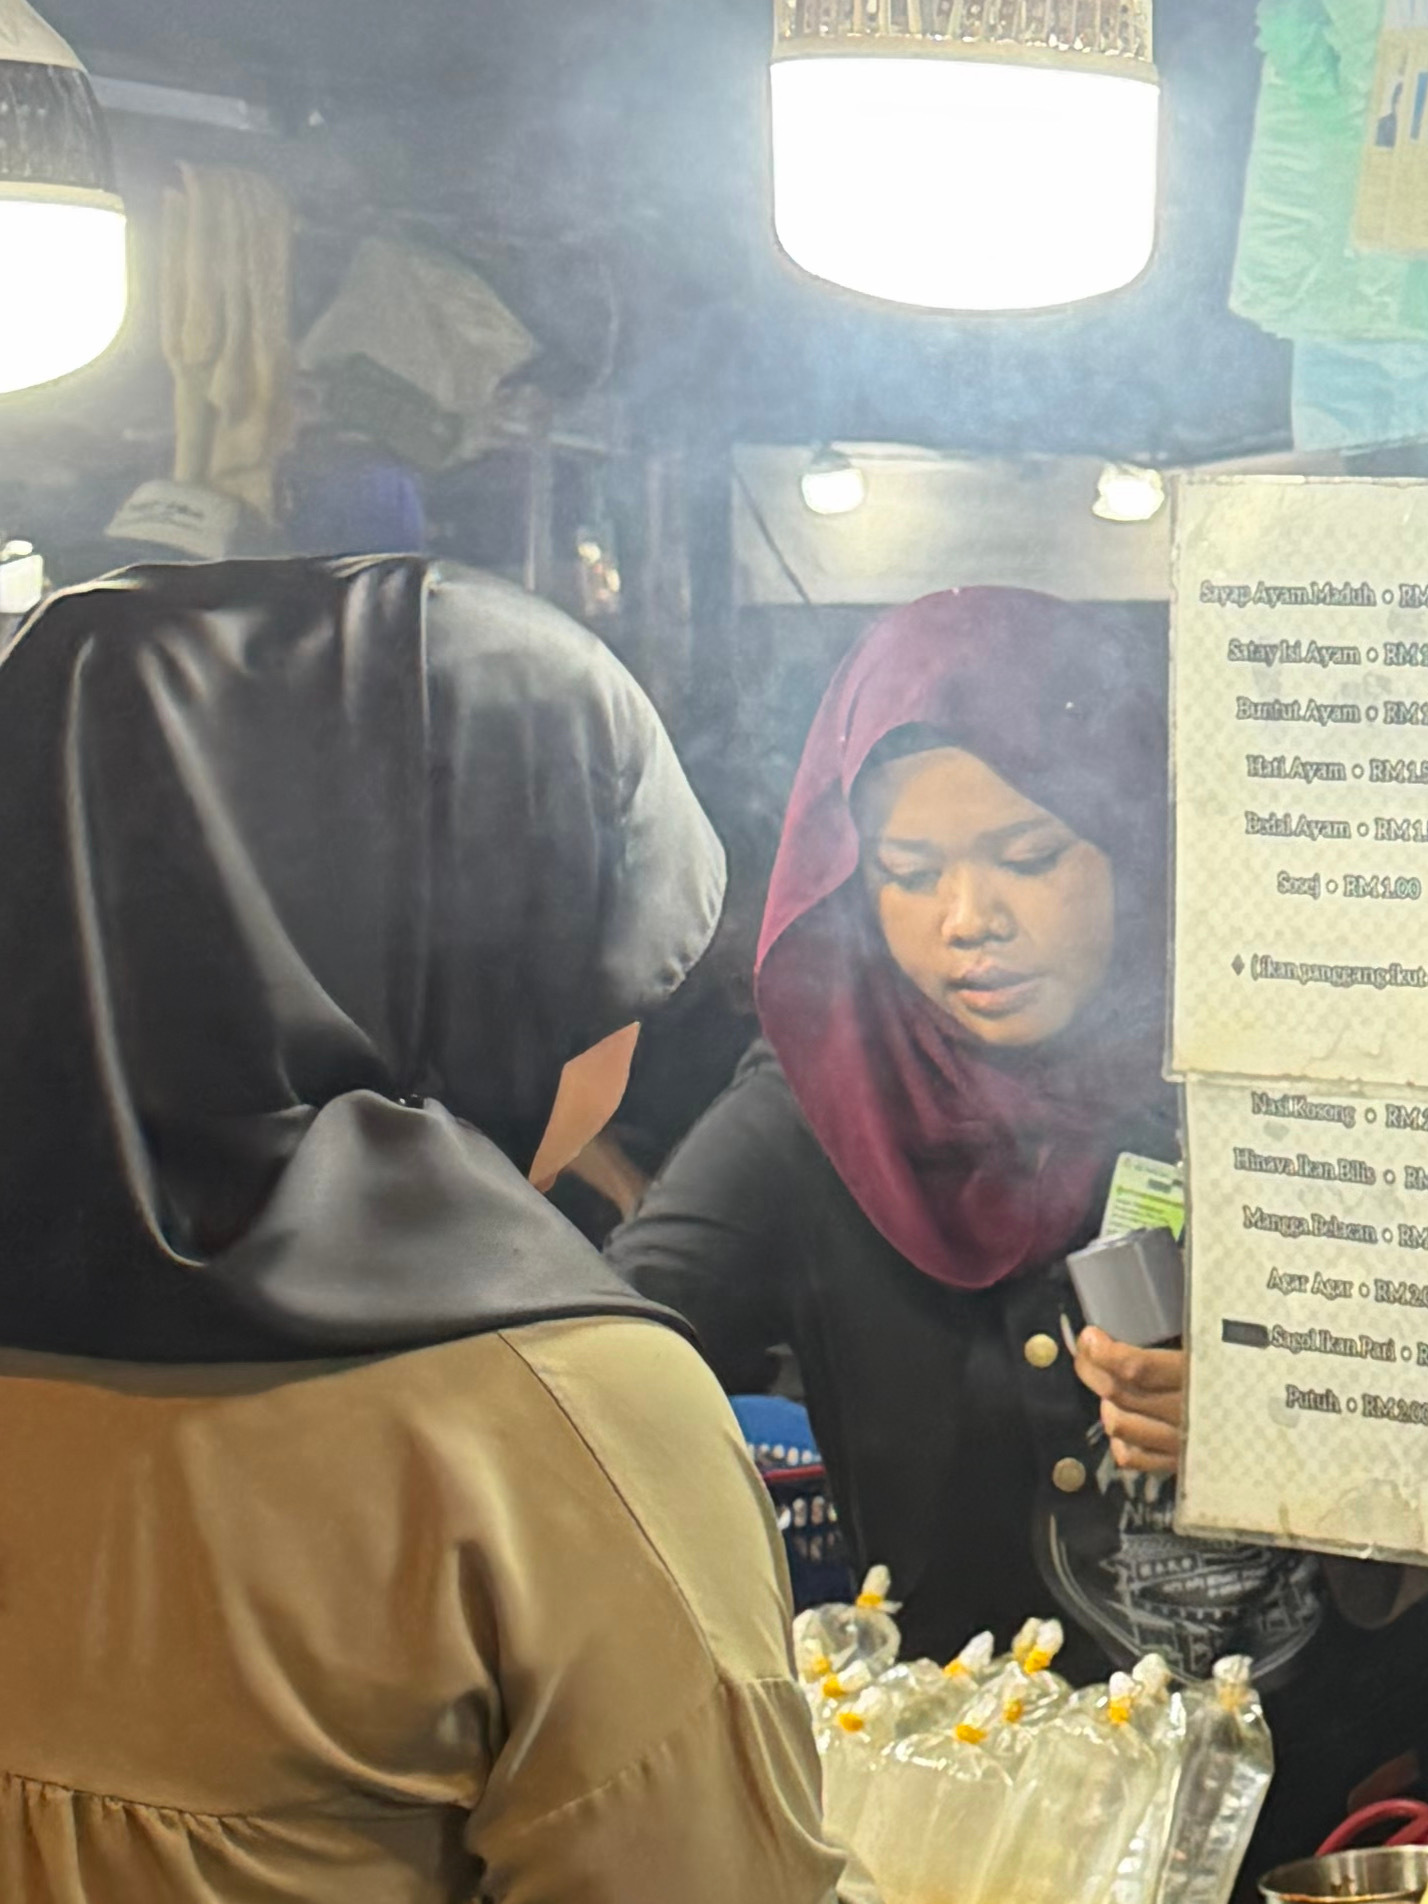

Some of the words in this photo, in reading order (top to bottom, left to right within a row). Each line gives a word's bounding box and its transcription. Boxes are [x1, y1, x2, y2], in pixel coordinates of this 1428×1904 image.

[1200, 580, 1250, 607] Sayap
[1253, 580, 1308, 608] Ayam
[1227, 638, 1278, 666] Satay
[1305, 640, 1361, 667] Ayam
[1236, 696, 1302, 721] Buntut
[1304, 698, 1361, 726] Ayam
[1246, 754, 1289, 778] Hati
[1290, 756, 1346, 783] Ayam
[1295, 815, 1352, 840] Ayam
[1277, 870, 1320, 899] Sosej
[1299, 962, 1388, 989] panggang
[1251, 1091, 1289, 1115] Nasi
[1289, 1095, 1356, 1128] Kosong
[1233, 1147, 1296, 1176] Hinava
[1297, 1153, 1337, 1180] Ikan
[1337, 1158, 1376, 1185] Bilis
[1242, 1205, 1310, 1238] Mangga
[1311, 1213, 1378, 1244] Belacan
[1267, 1267, 1308, 1295] Agar
[1311, 1271, 1353, 1300] Agar
[1319, 1329, 1360, 1357] Ikan
[1359, 1334, 1396, 1362] Pari
